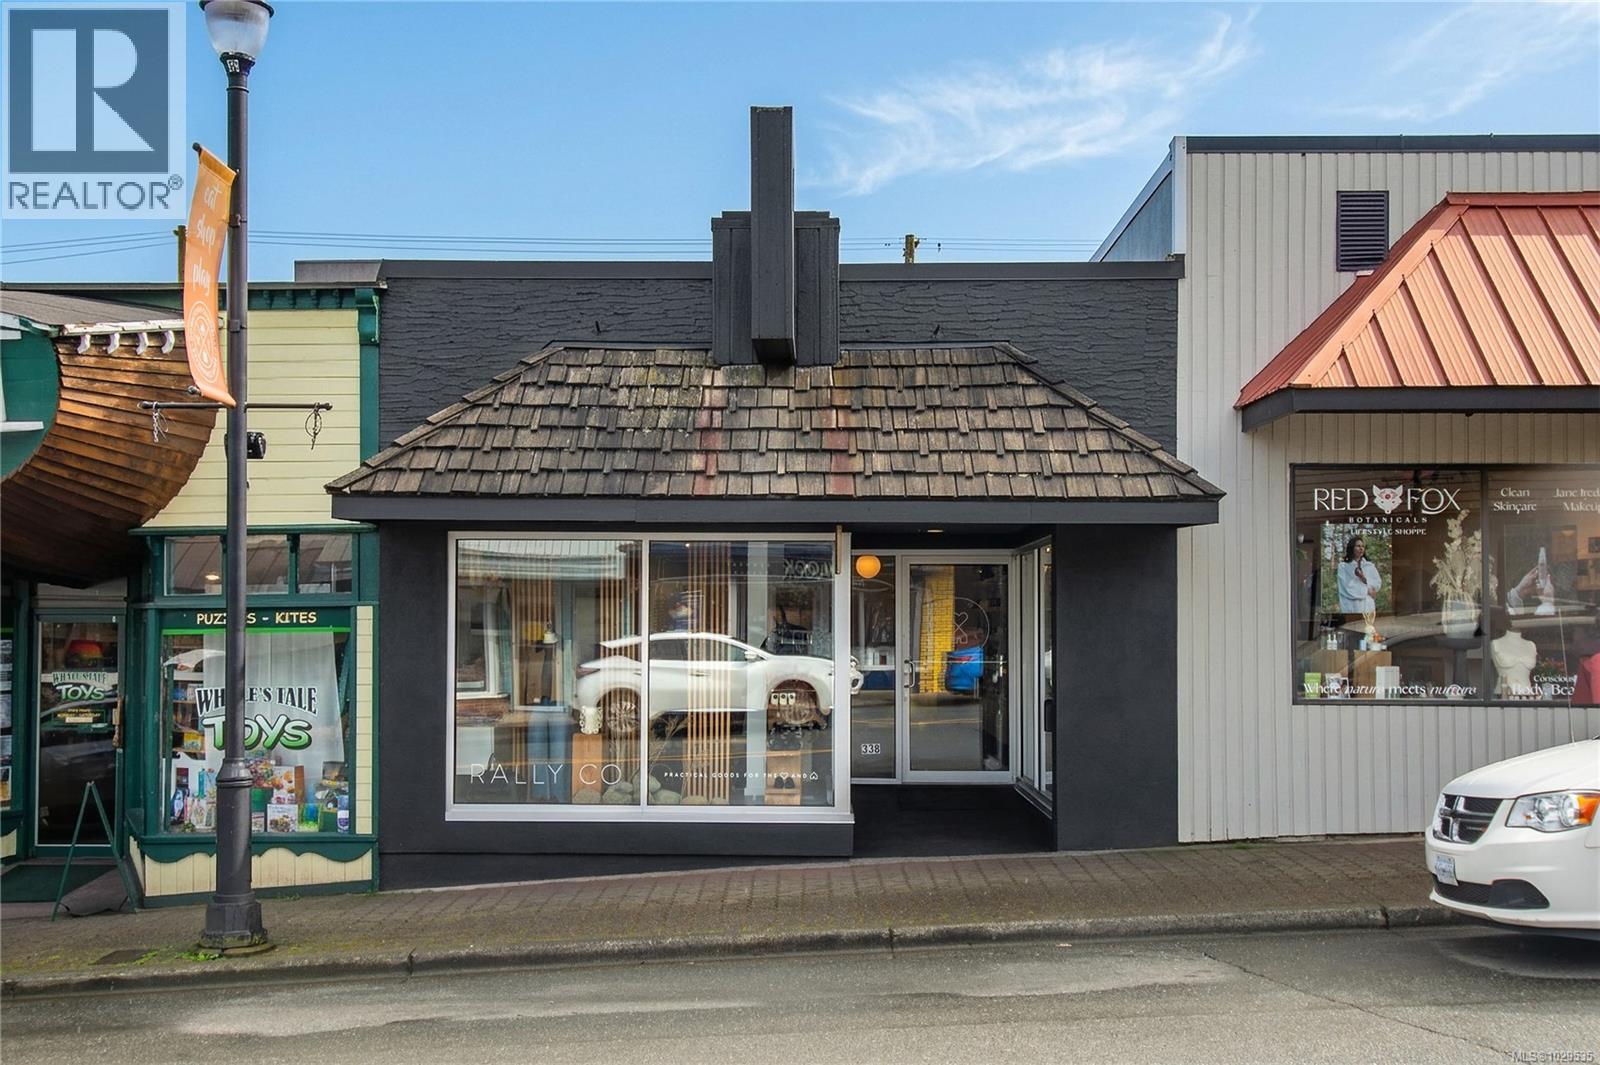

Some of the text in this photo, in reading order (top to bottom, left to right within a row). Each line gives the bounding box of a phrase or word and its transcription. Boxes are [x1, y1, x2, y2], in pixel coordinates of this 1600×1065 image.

[196, 214, 217, 256] shop
[192, 256, 212, 297] play
[1500, 487, 1530, 497] Clean
[1553, 487, 1578, 498] Jane
[1314, 487, 1461, 515] RED FOX
[1348, 516, 1428, 524] BOTANICALS
[1395, 528, 1427, 536] SHOPPE
[275, 611, 317, 624] KITES
[55, 683, 105, 701] TOYS
[1303, 683, 1341, 694] Where
[1388, 684, 1427, 695] meets
[275, 686, 319, 717] TALE
[862, 744, 880, 754] 338
[470, 763, 622, 785] RALLY CO
[791, 771, 808, 779] AND
